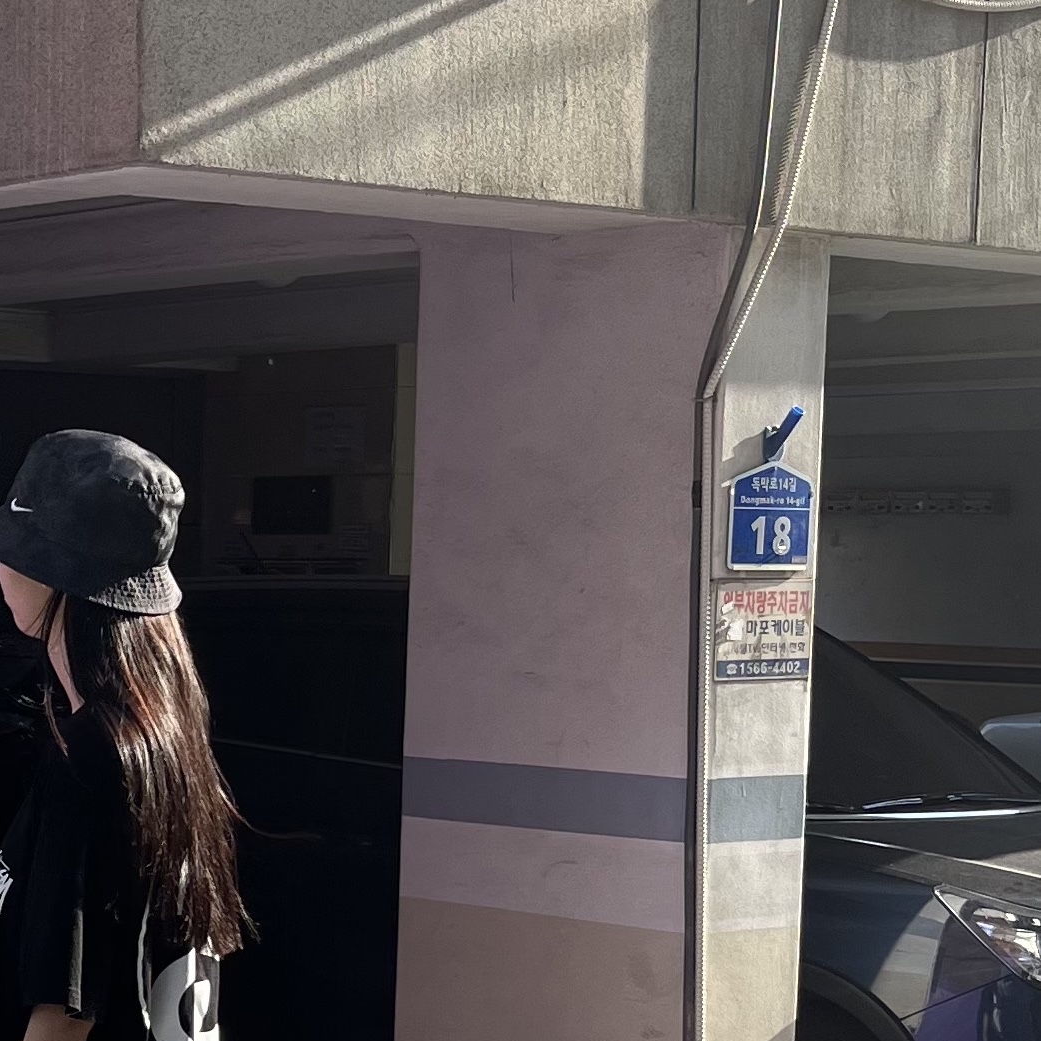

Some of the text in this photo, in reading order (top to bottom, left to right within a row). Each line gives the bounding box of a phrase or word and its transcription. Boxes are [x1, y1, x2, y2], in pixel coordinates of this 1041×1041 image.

[751, 477, 797, 492] 독막로14길
[750, 516, 791, 555] 18
[746, 618, 805, 637] 마포케이블
[739, 661, 800, 675] 1566-4402
